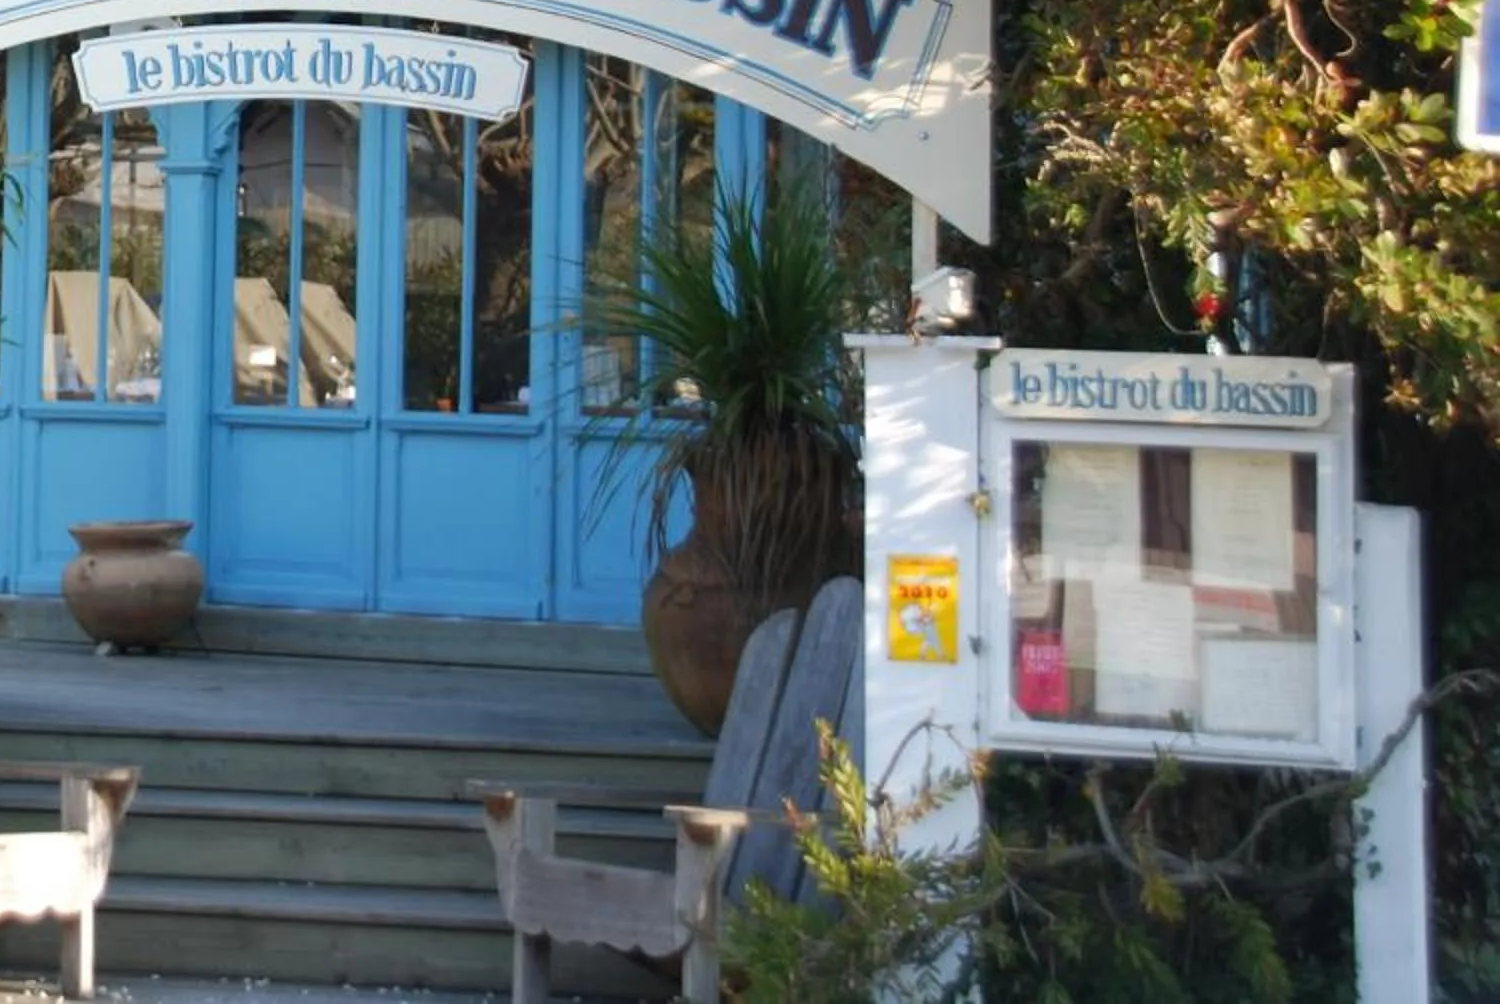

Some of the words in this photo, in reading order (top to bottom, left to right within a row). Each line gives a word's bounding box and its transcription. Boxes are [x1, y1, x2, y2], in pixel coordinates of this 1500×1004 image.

[121, 49, 162, 94] le
[167, 39, 299, 92] bistrot
[309, 38, 352, 86] du
[362, 42, 477, 101] bassin
[1009, 361, 1042, 405] le
[1045, 362, 1163, 412] bistrot
[1170, 366, 1208, 413] du
[1211, 367, 1318, 417] bassin
